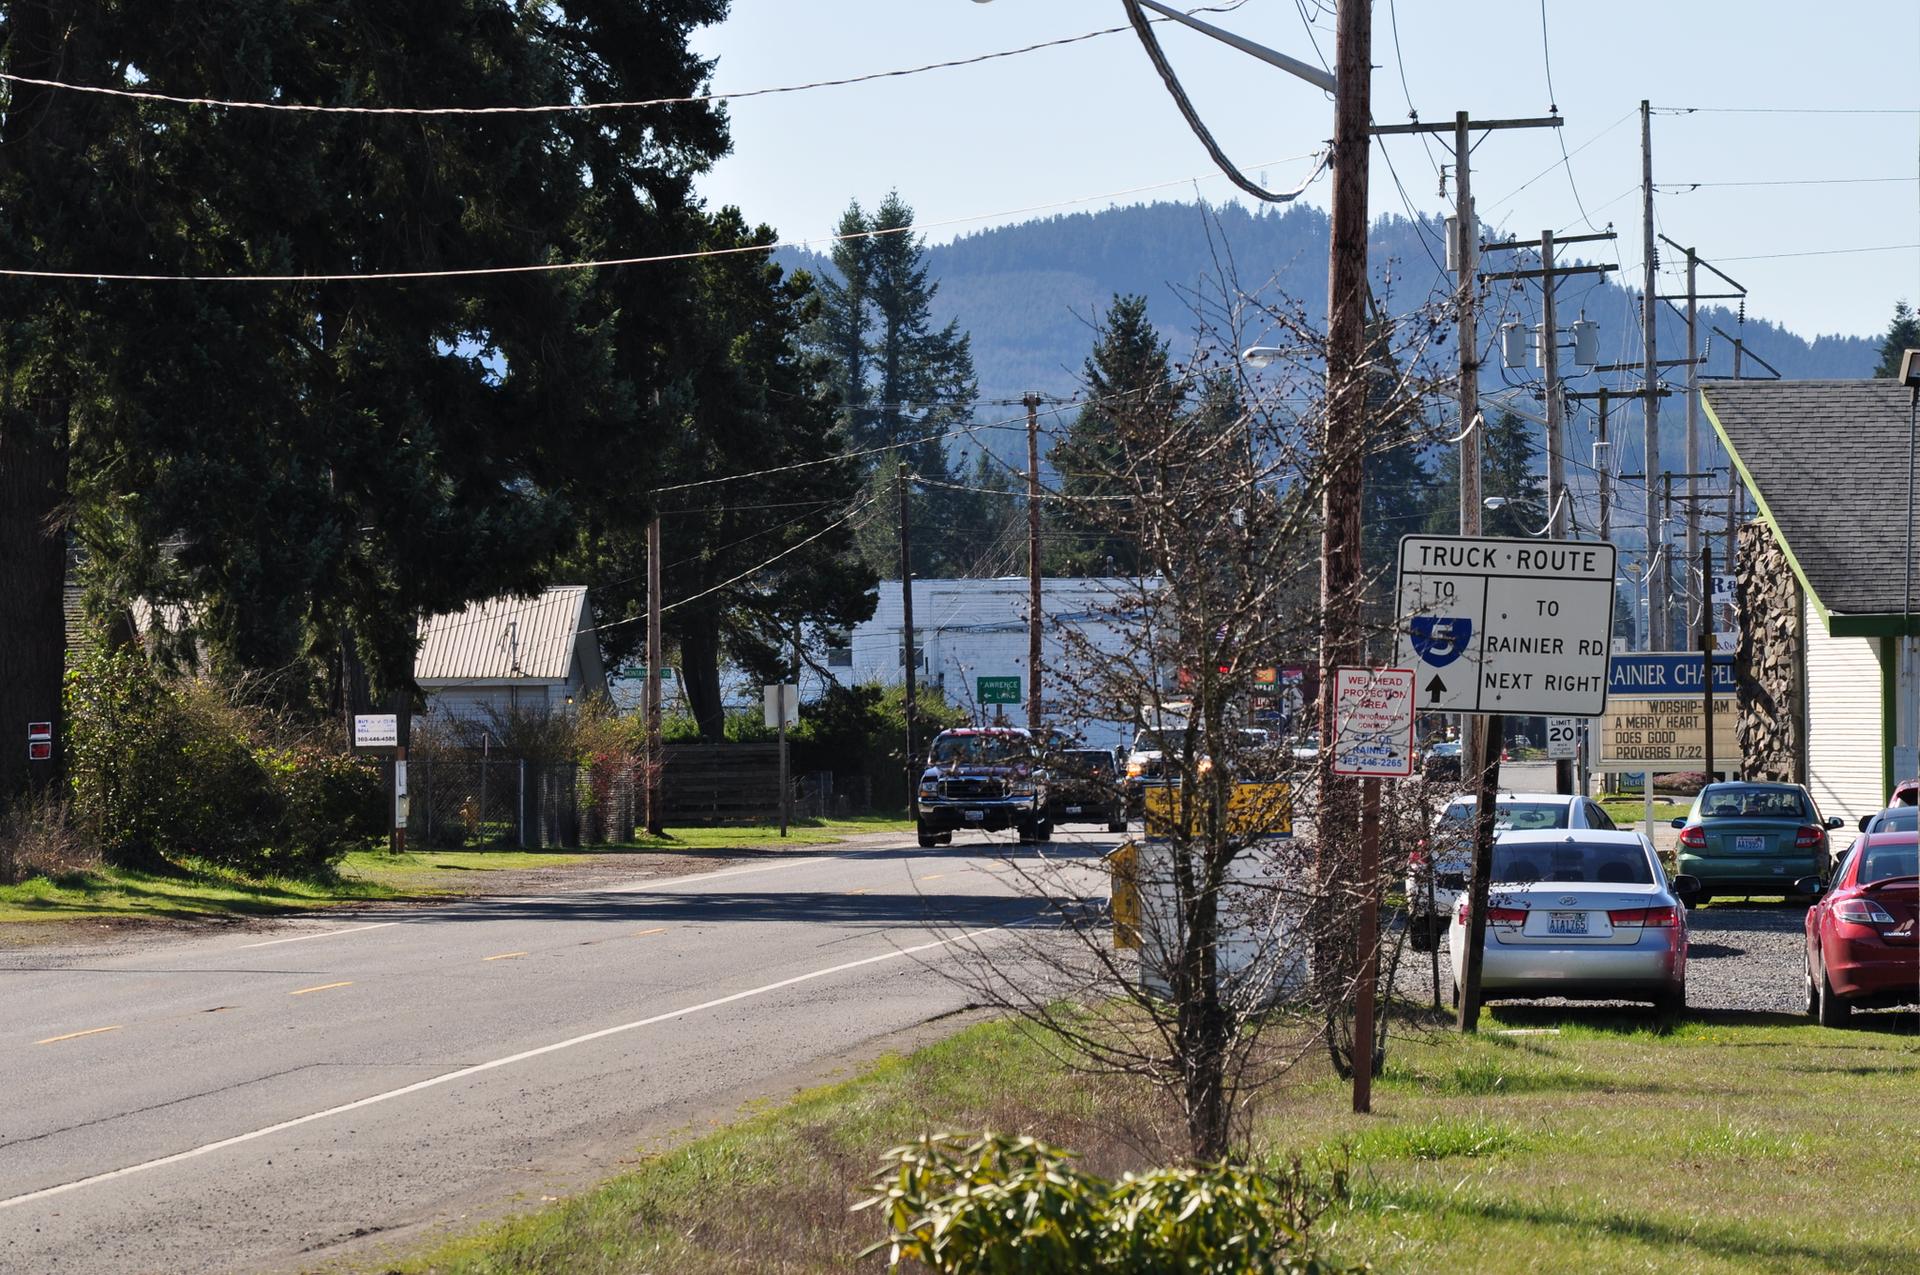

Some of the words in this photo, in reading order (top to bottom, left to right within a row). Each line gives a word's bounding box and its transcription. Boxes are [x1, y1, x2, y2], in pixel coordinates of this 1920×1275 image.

[1419, 545, 1498, 568] TRUCK
[1517, 550, 1596, 572] ROUTE
[1433, 581, 1455, 598] TO
[1536, 600, 1559, 616] TO
[1429, 624, 1455, 656] 5
[1487, 636, 1563, 654] RAINIER
[1348, 676, 1403, 686] WELHEAD
[1674, 663, 1736, 684] CHAPEL
[1485, 673, 1533, 690] NEXT
[1545, 675, 1601, 693] RIGHT
[1343, 688, 1406, 698] PROTECTION
[1360, 701, 1388, 709] AREA
[1615, 716, 1622, 728] A
[1626, 716, 1662, 728] MERRY
[1666, 716, 1699, 728] HEART
[1549, 727, 1574, 741] 20
[1615, 731, 1642, 744] DOES
[1648, 731, 1676, 743] GOOD
[1616, 746, 1671, 759] PROVERBS
